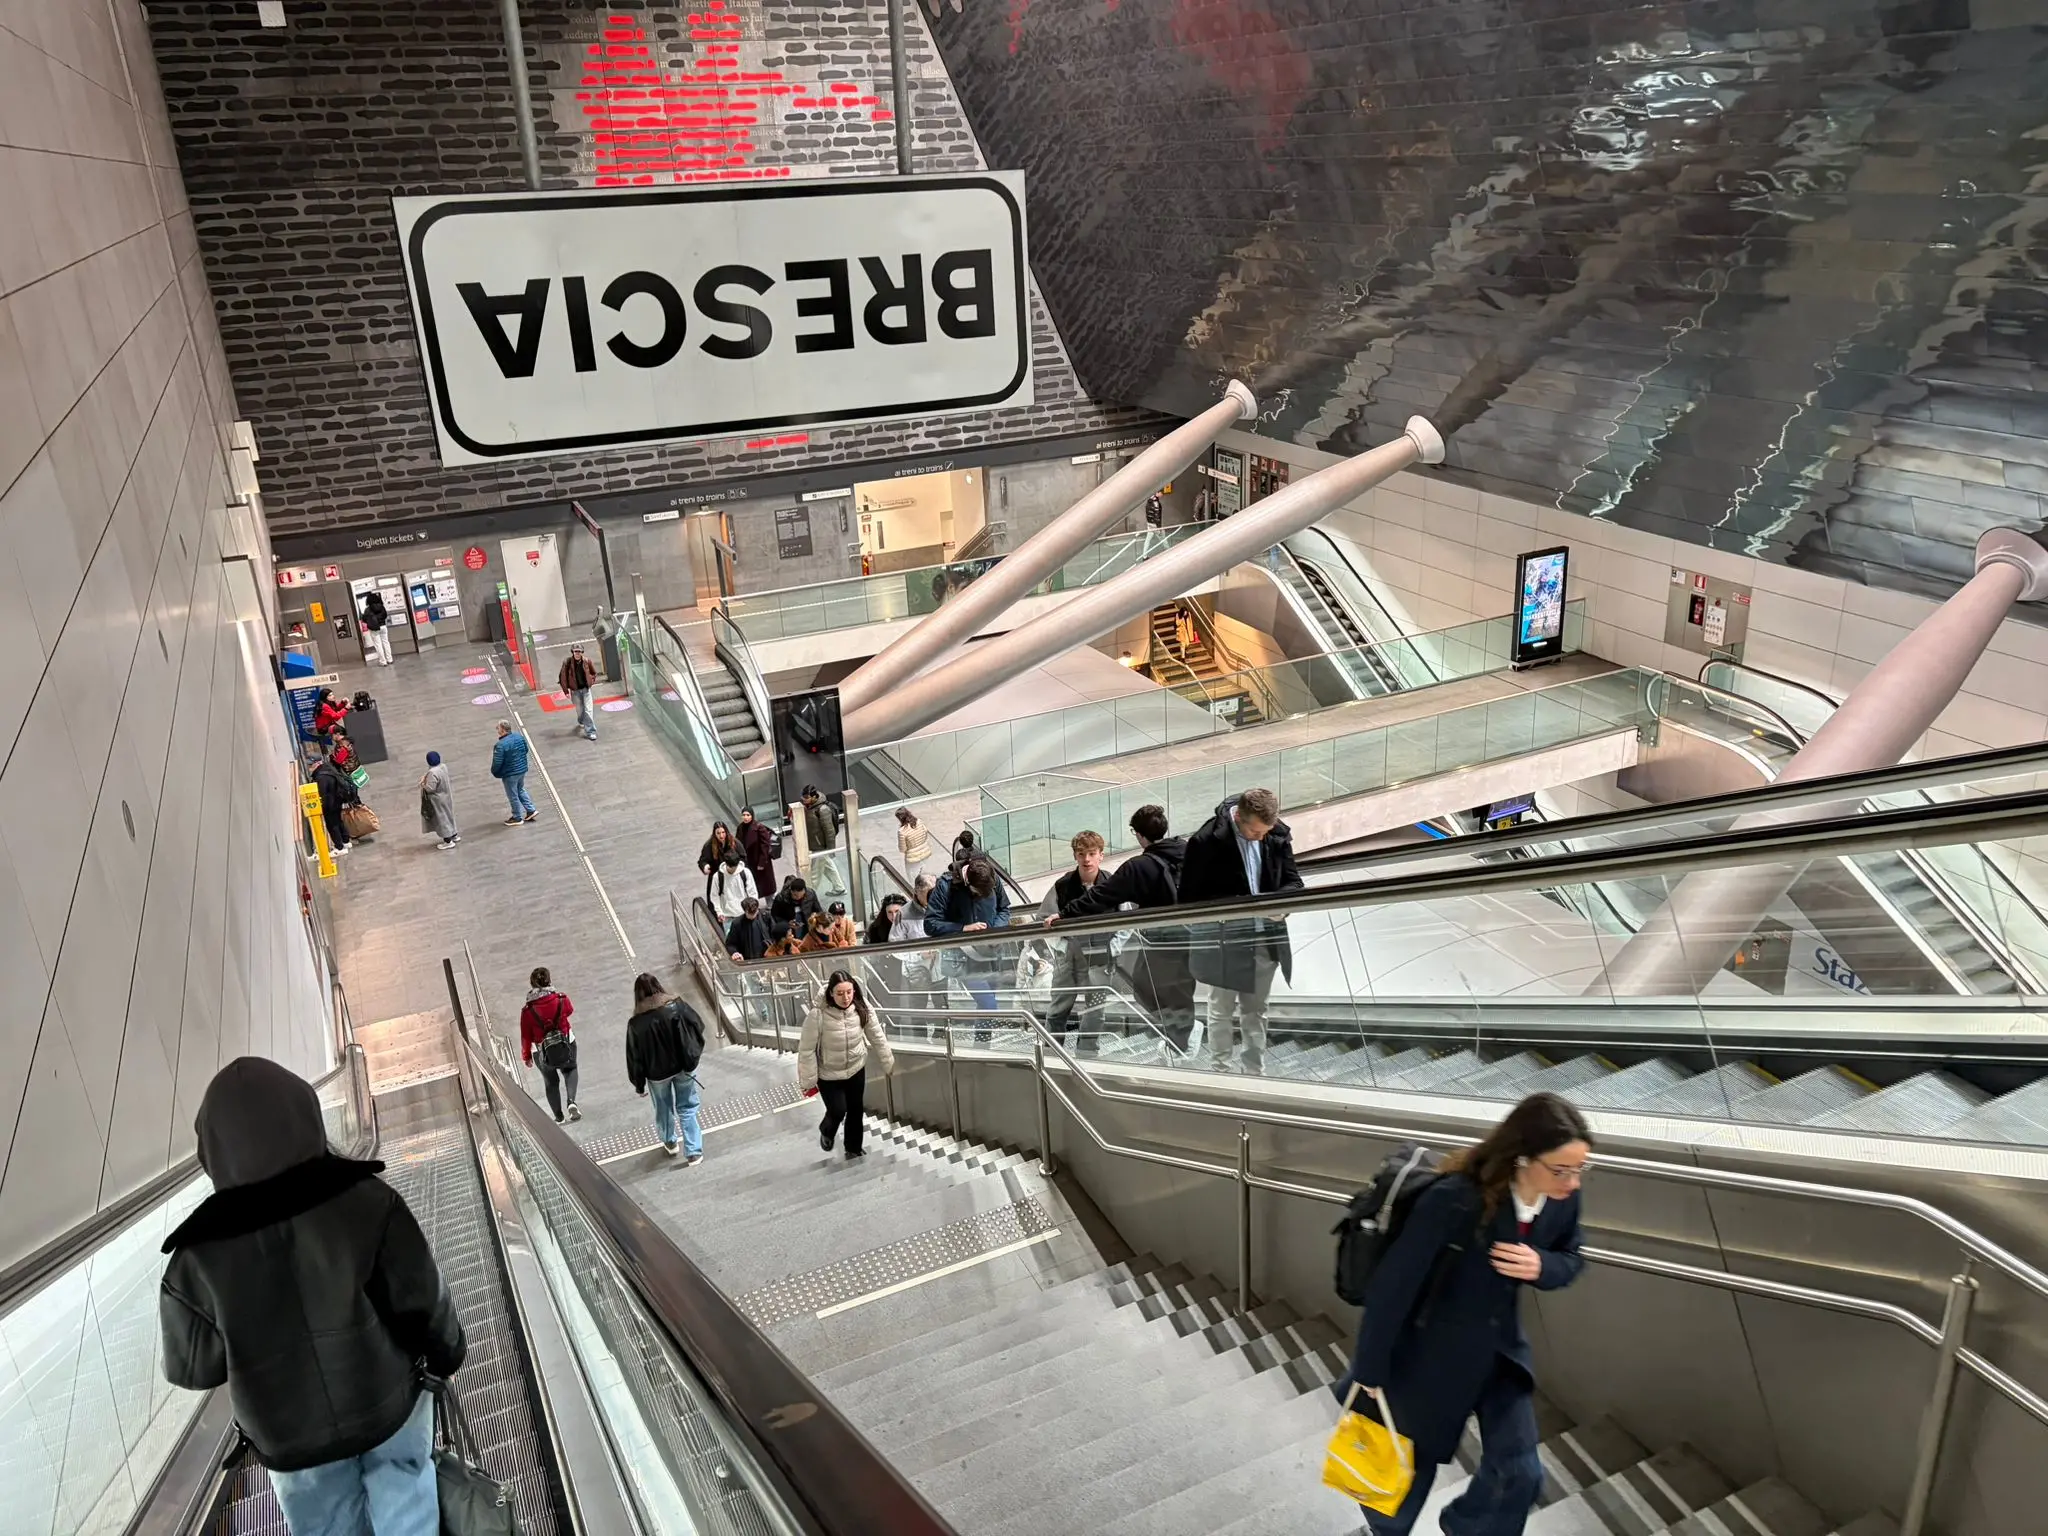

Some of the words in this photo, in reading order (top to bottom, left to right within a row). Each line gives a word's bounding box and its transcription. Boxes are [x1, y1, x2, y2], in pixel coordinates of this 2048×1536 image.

[455, 248, 997, 379] BRESCIA
[678, 496, 696, 505] treni
[356, 536, 388, 549] biglietti
[389, 533, 414, 544] tickets
